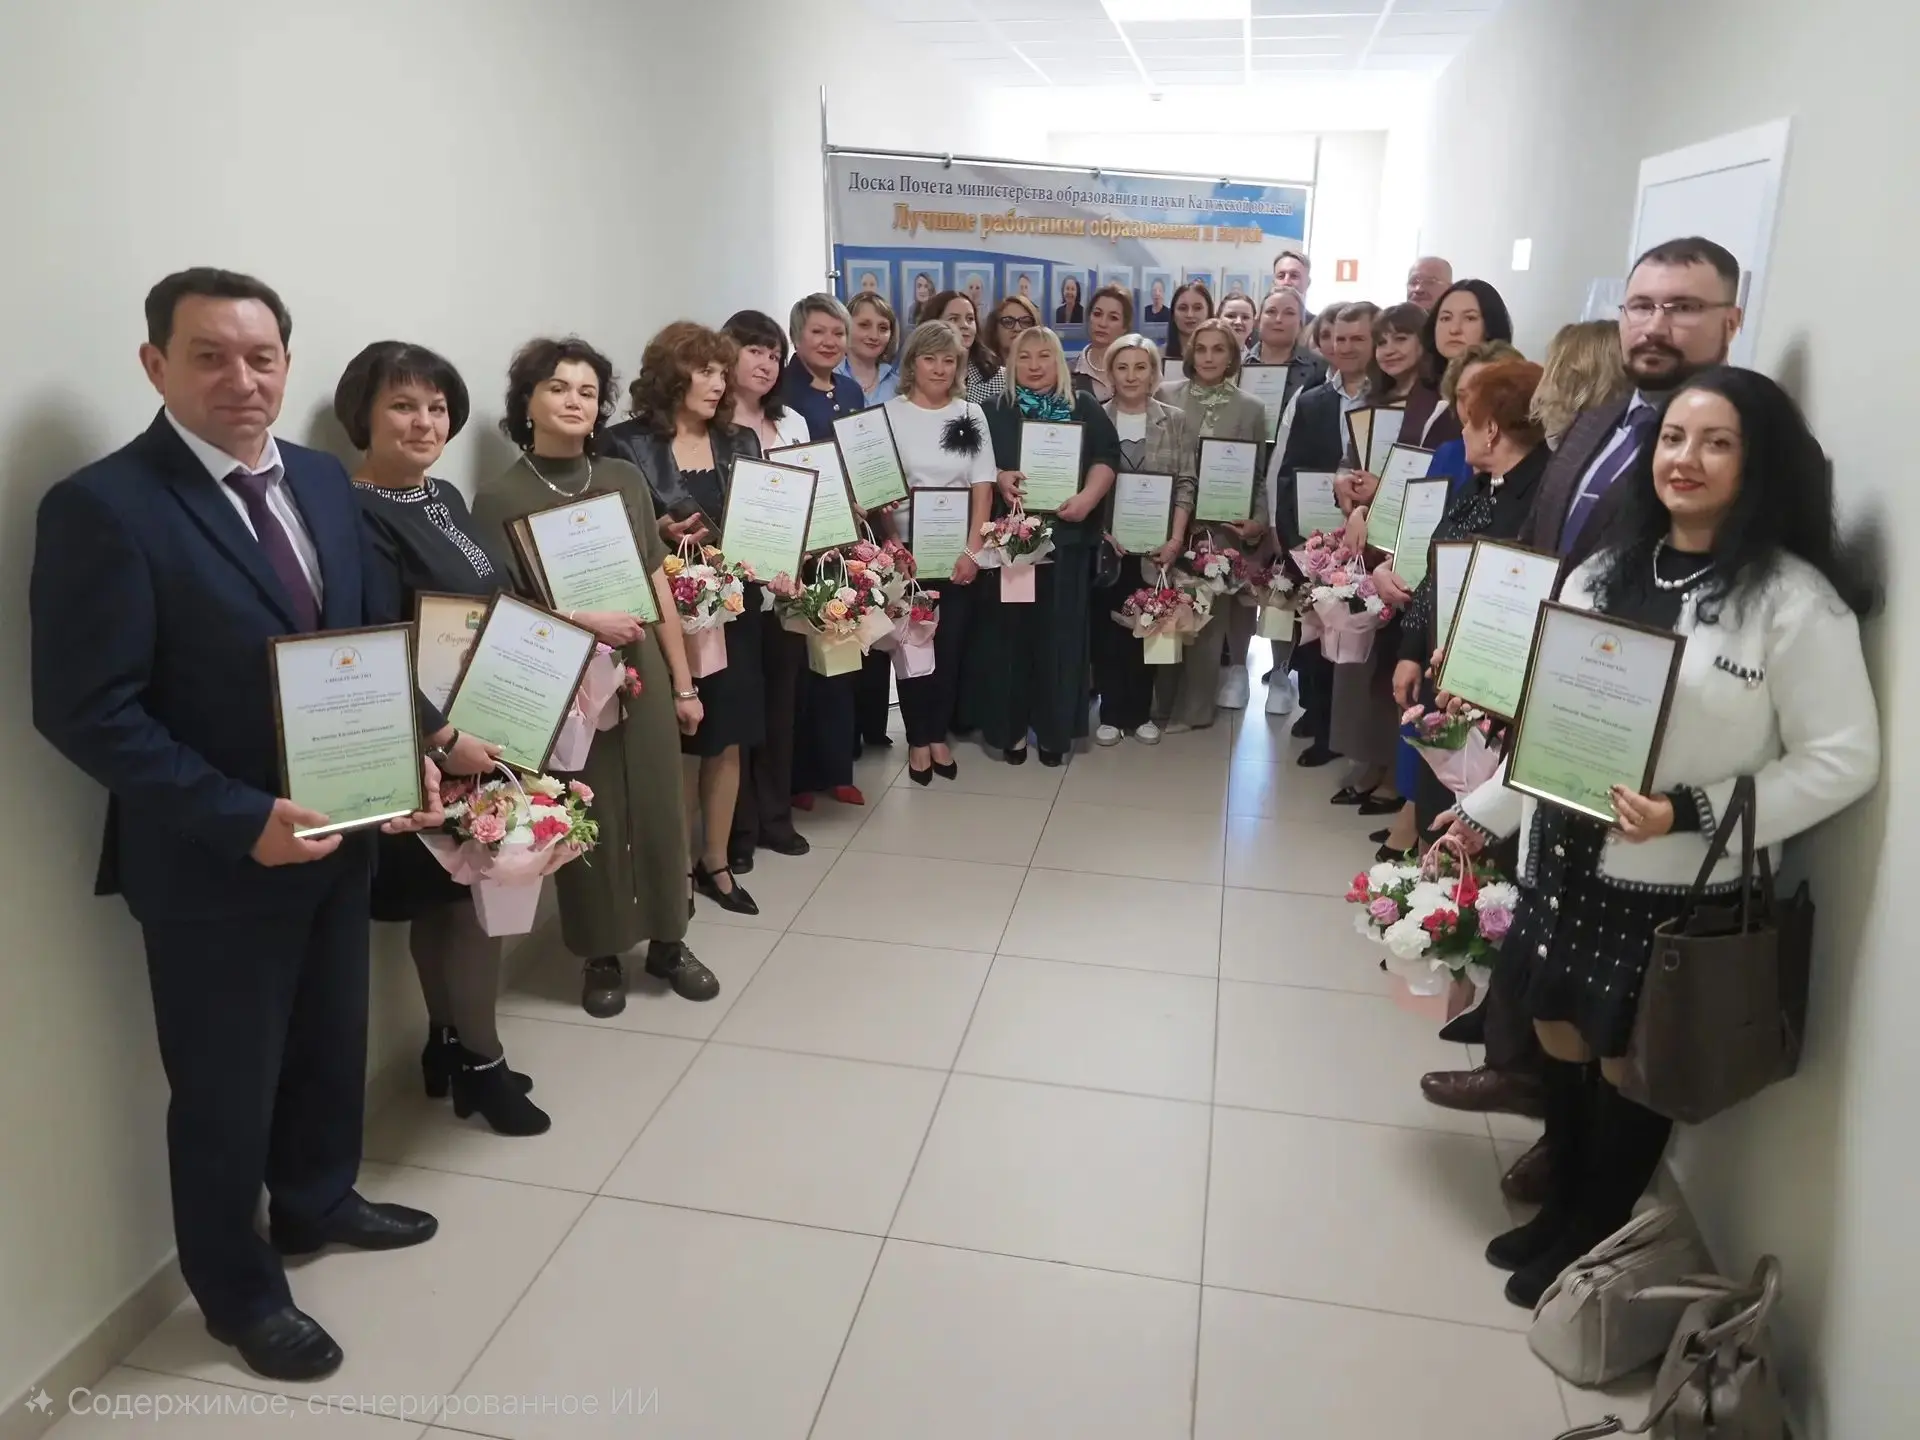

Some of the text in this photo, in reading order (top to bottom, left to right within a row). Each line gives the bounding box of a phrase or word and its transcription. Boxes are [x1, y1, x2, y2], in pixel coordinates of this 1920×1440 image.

[849, 172, 895, 192] Доска
[900, 175, 952, 195] Почета
[957, 183, 1052, 204] министерства
[1057, 185, 1138, 207] образования
[1139, 195, 1148, 206] и
[1151, 195, 1184, 210] науки
[893, 202, 976, 238] Лучшие
[980, 207, 1085, 239] работники
